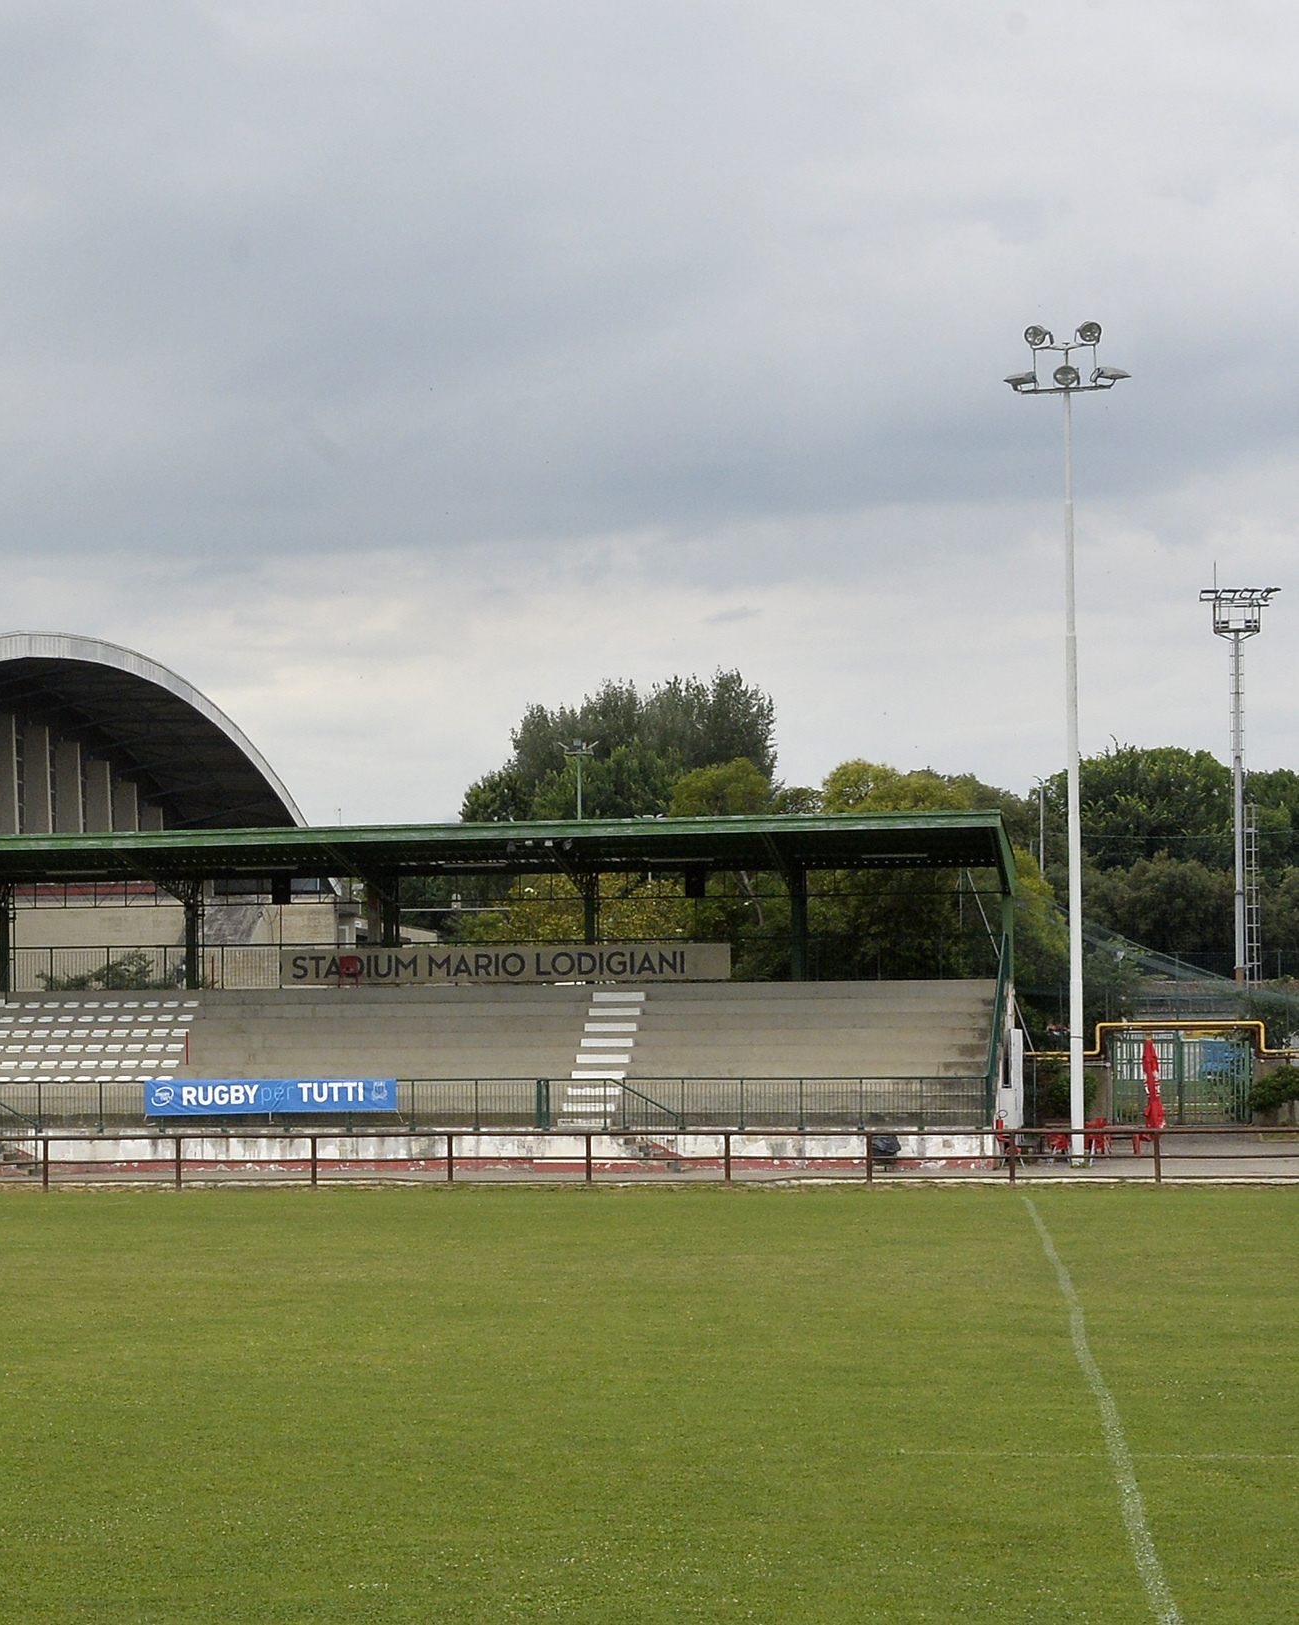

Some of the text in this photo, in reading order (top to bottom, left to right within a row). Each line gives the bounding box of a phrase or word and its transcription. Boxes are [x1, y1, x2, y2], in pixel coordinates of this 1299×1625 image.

[428, 952, 526, 978] MARIO
[535, 950, 686, 976] LODIGIANI
[182, 1084, 259, 1106] RUGBY
[261, 1085, 295, 1106] per
[298, 1081, 364, 1102] TUTTI
